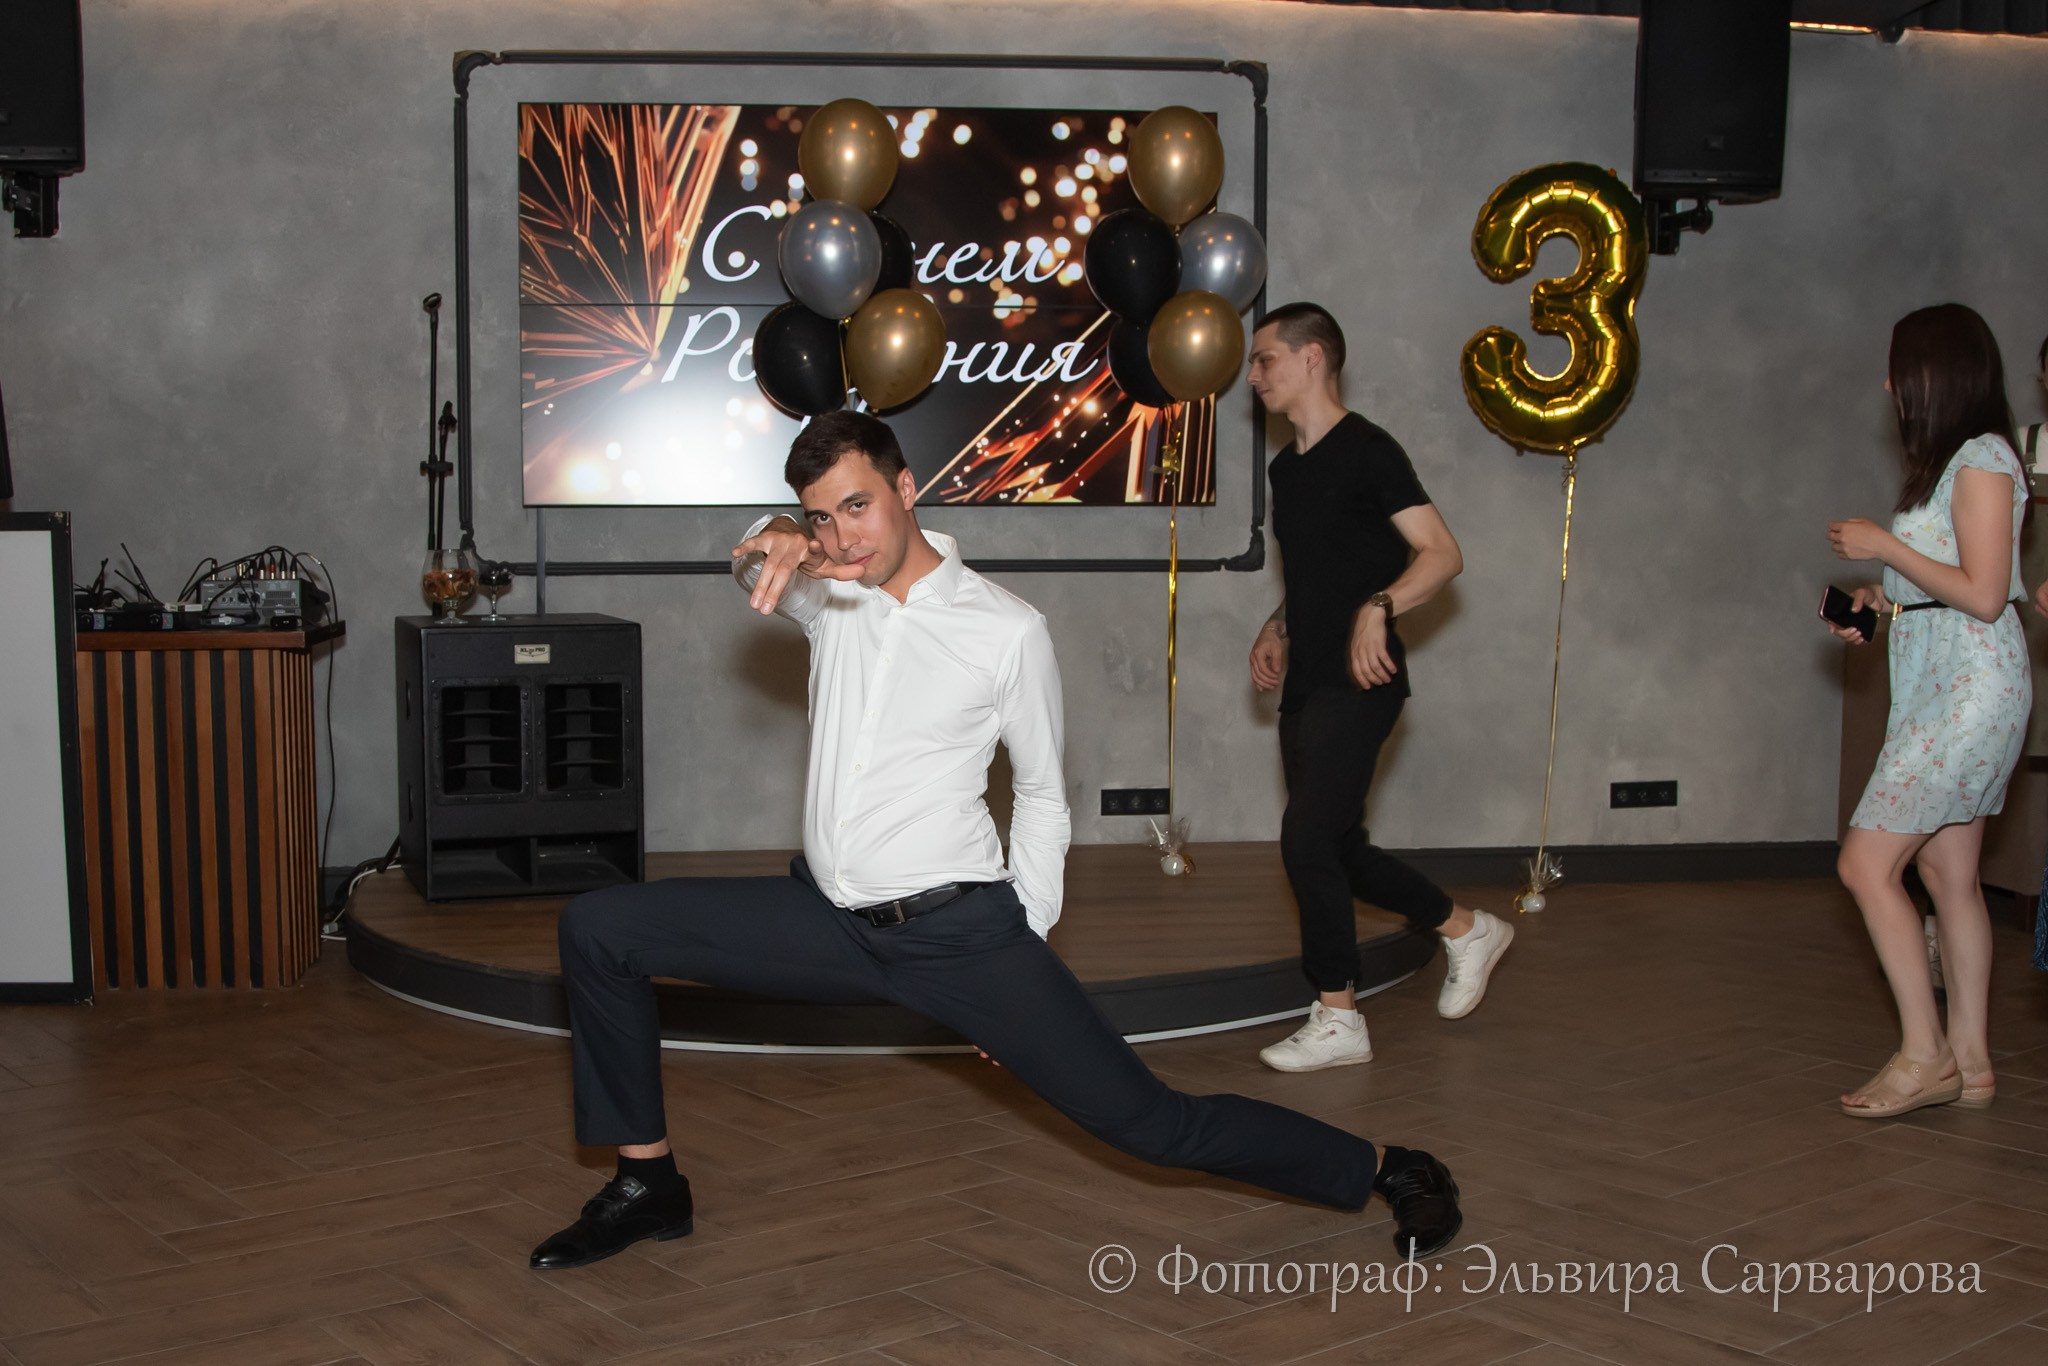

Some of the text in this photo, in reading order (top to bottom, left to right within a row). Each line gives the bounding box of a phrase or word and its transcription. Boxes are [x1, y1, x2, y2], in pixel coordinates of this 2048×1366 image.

[702, 204, 1066, 283] С нем
[1462, 162, 1647, 452] 3
